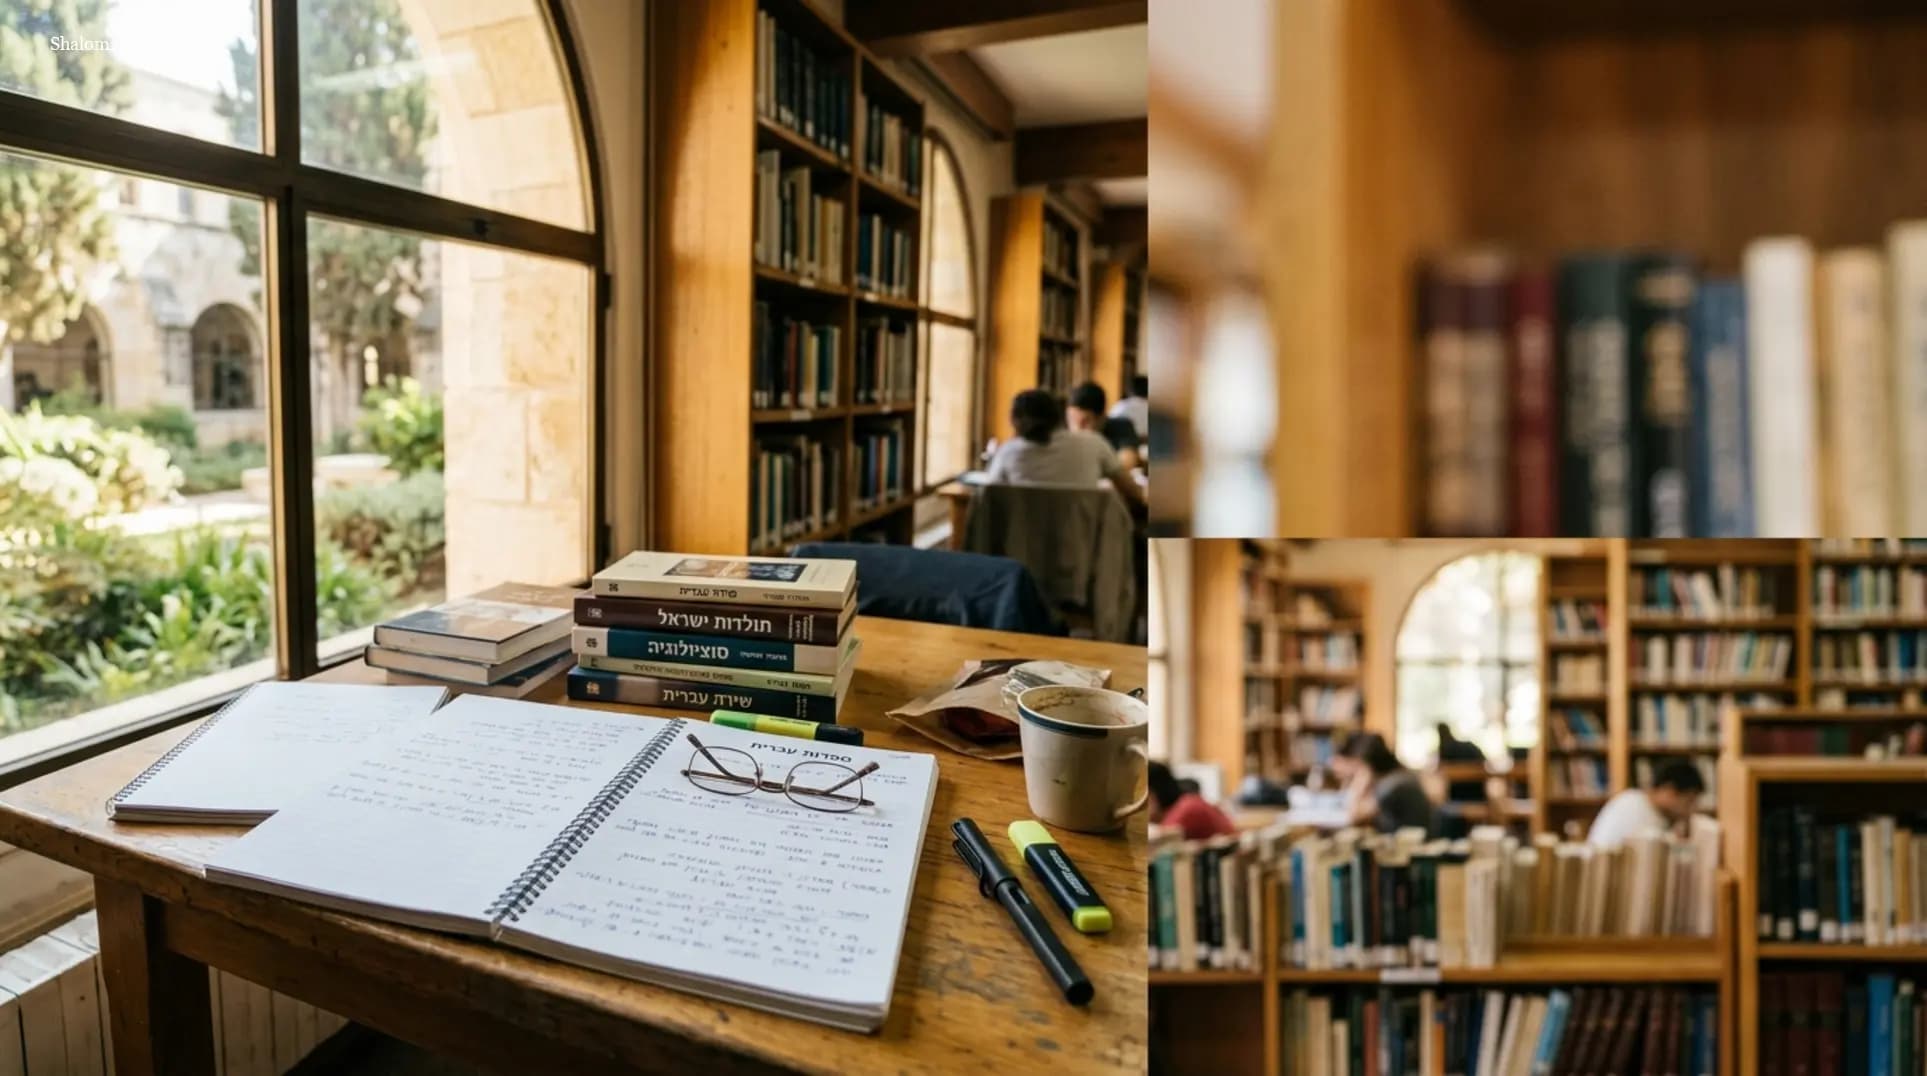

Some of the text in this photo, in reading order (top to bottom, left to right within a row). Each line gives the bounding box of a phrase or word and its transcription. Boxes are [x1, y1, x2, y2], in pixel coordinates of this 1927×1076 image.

[657, 608, 709, 628] ישראל
[714, 613, 772, 633] תולדות
[648, 639, 729, 659] סוציולוגיה
[663, 689, 708, 704] עברית
[751, 742, 852, 763] ספרות עברית
